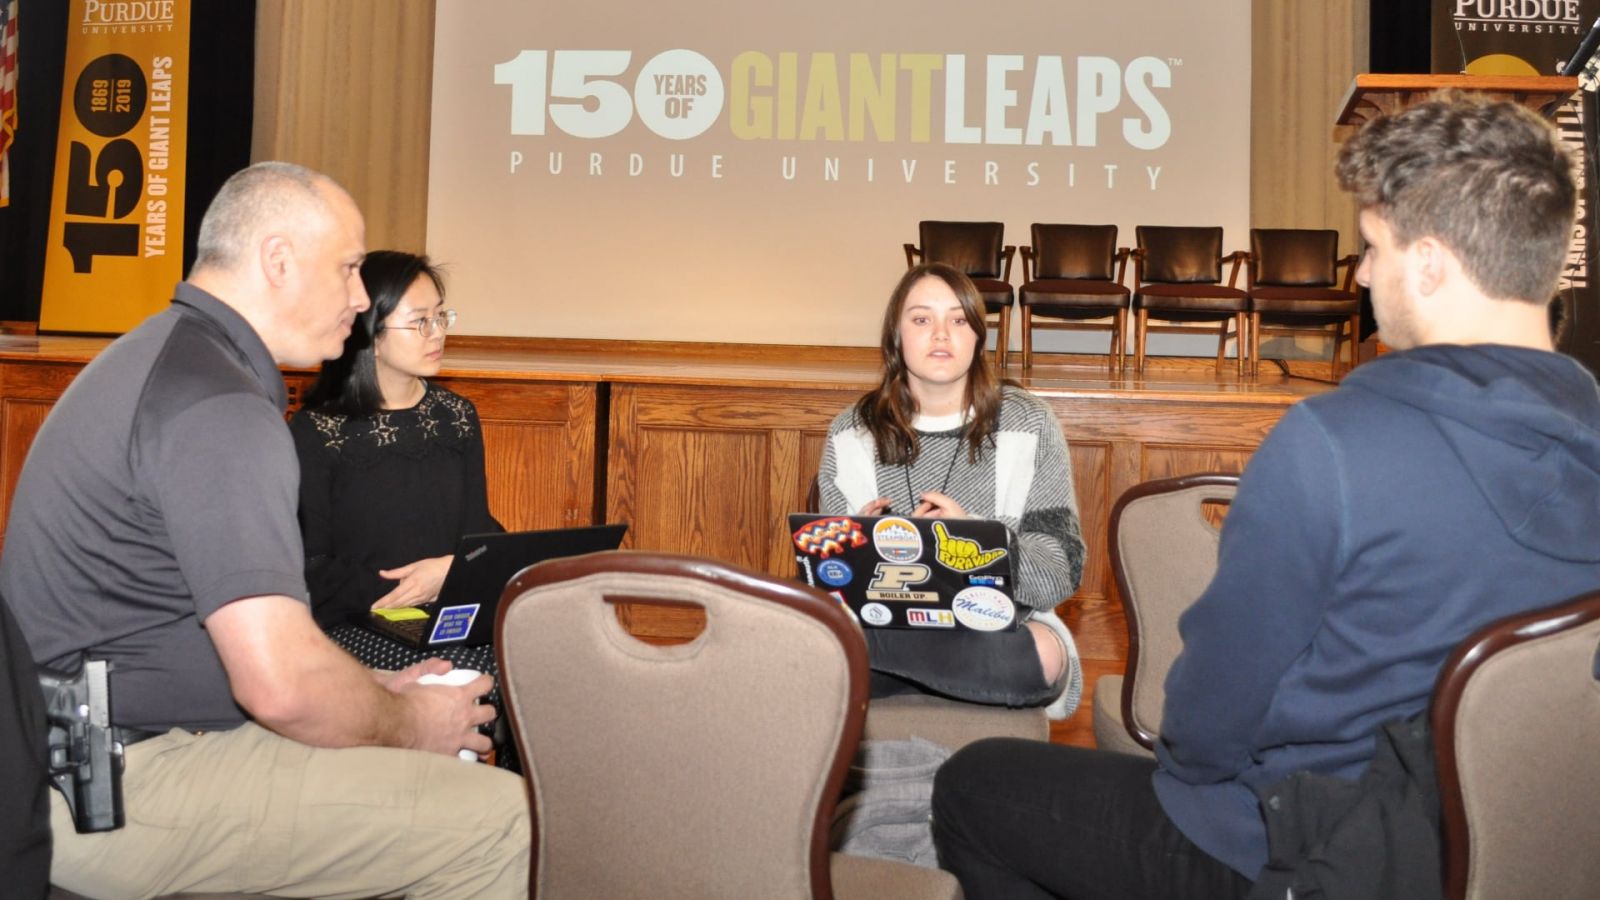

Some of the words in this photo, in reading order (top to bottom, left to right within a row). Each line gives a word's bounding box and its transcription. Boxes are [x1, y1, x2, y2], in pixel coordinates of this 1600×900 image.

[82, 0, 174, 22] PURDUE
[1453, 0, 1580, 20] PURDUE
[82, 24, 173, 34] UNIVERSITY
[1454, 22, 1580, 34] UNIVERSITY
[91, 79, 109, 112] 1869
[116, 79, 132, 112] 2019
[151, 55, 173, 112] LEAPS
[653, 74, 707, 97] YEARS
[664, 98, 695, 119] OF
[148, 115, 171, 170] GIANT
[511, 151, 724, 178] PURDUE
[782, 156, 1162, 191] UNIVERSITY
[147, 173, 169, 197] OF
[145, 200, 168, 258] YEARS
[909, 610, 953, 624] MLH
[956, 597, 1010, 623] Malibu
